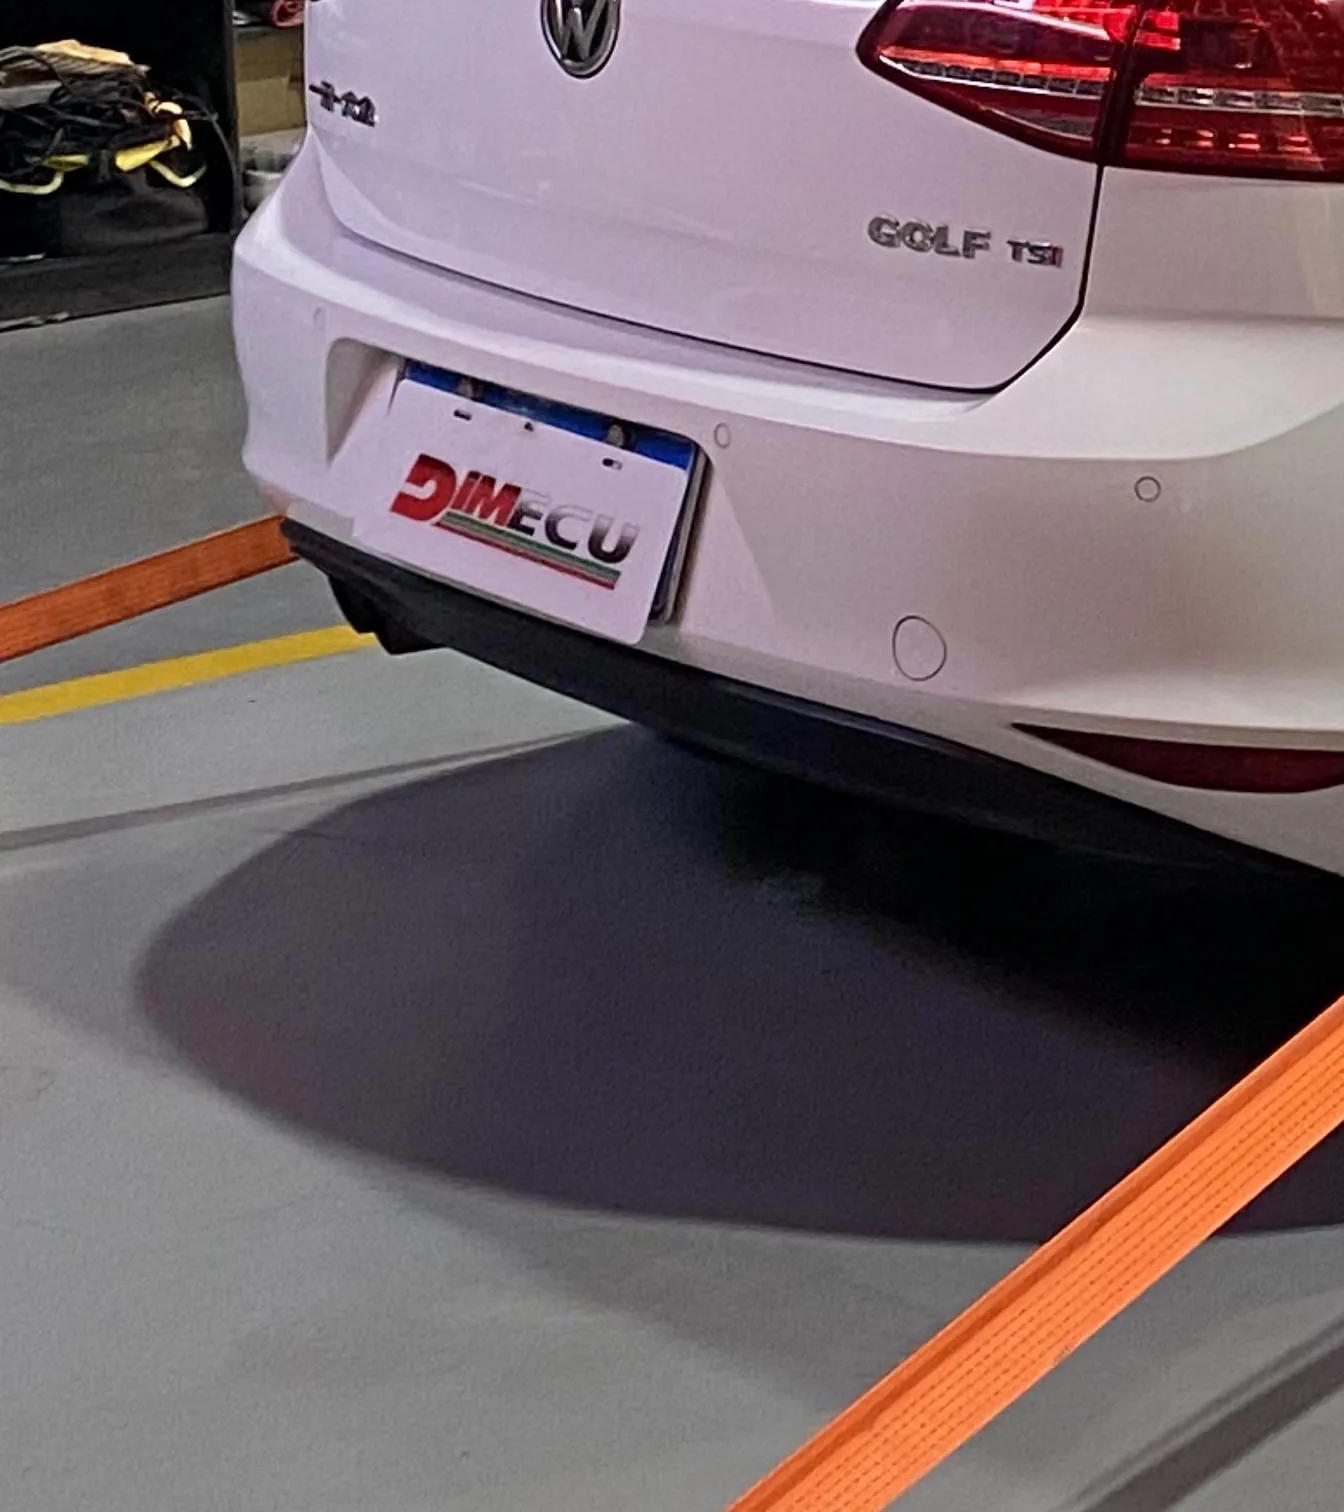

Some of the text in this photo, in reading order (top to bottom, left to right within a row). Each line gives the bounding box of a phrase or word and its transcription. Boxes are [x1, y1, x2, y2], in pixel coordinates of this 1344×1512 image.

[867, 215, 1064, 268] GOLF TSI
[390, 453, 641, 564] DIMECU
